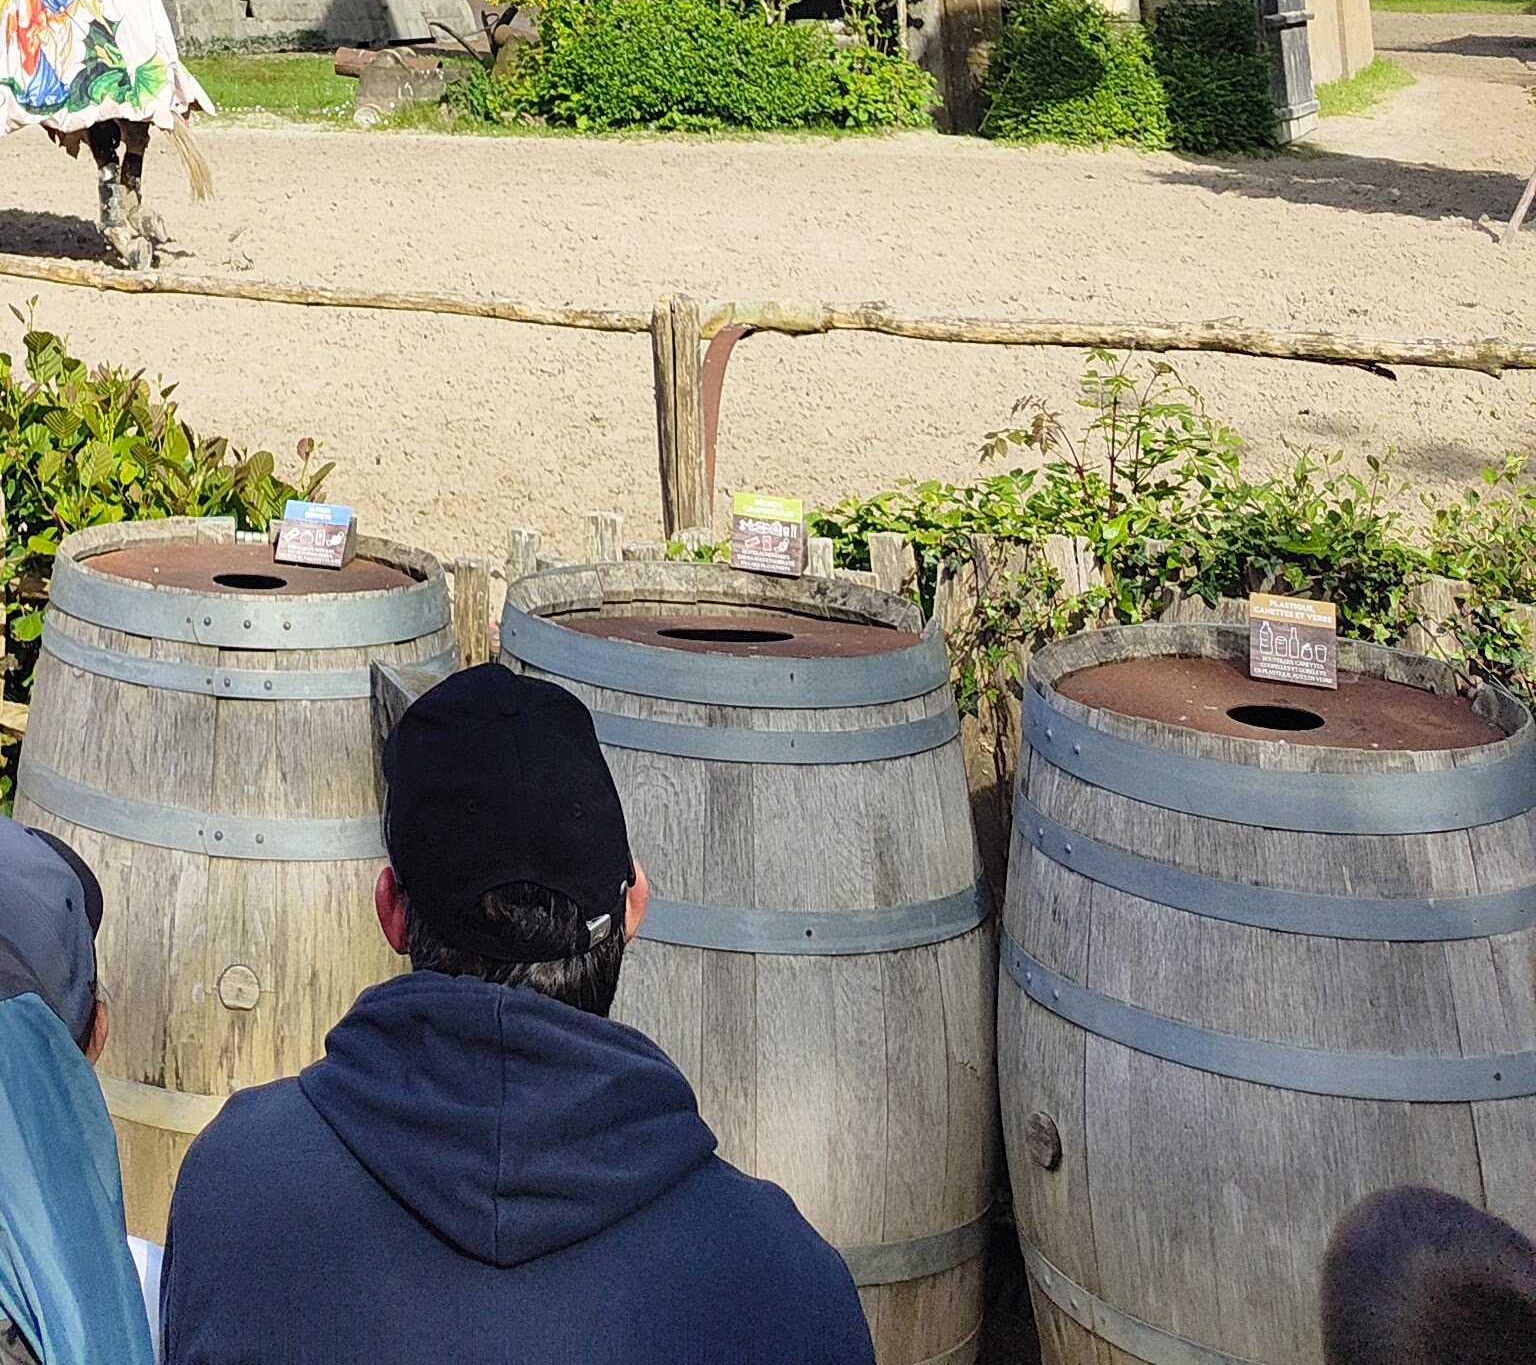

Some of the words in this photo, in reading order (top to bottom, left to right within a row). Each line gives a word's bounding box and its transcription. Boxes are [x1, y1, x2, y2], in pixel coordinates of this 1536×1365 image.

[1269, 600, 1316, 613] PLASTIQUE,
[1253, 606, 1294, 618] CANETTES
[1295, 610, 1305, 620] ET
[1306, 612, 1333, 624] VERRE
